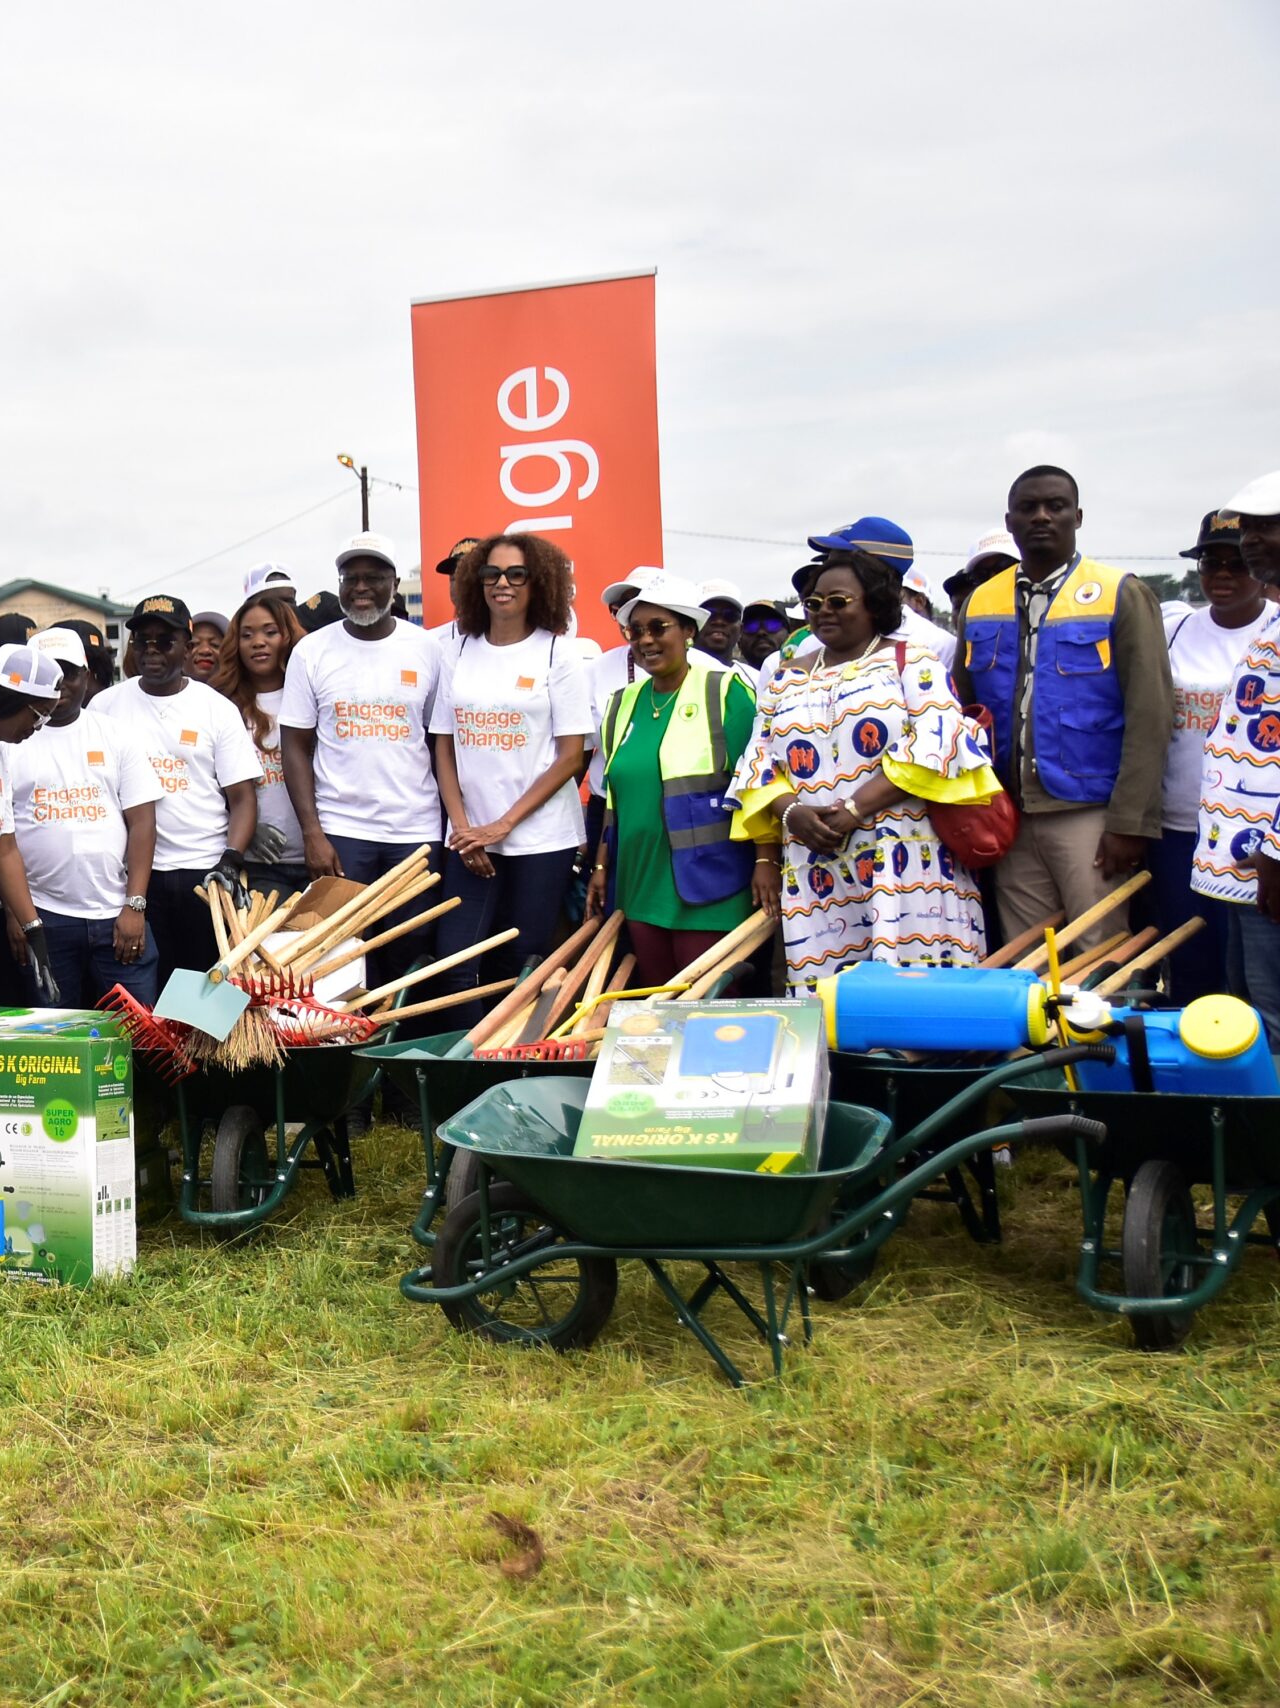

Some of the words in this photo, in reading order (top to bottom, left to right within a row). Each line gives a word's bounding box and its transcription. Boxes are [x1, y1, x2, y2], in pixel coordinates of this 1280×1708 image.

[335, 701, 406, 720] Engage
[454, 708, 521, 728] Engage
[336, 721, 410, 741] Change
[458, 728, 526, 751] Change
[151, 757, 185, 773] age
[34, 786, 100, 803] Engage
[34, 803, 107, 822] Change
[7, 1055, 17, 1072] K
[19, 1056, 81, 1074] ORIGINAL
[15, 1074, 27, 1086] Big
[28, 1074, 47, 1085] Farm
[46, 1109, 74, 1117] SUPER
[48, 1118, 72, 1126] AGRO
[55, 1127, 65, 1136] 16
[705, 1133, 719, 1144] S
[720, 1132, 738, 1144] K
[591, 1134, 684, 1146] ORIGINAL
[685, 1134, 704, 1145] K
